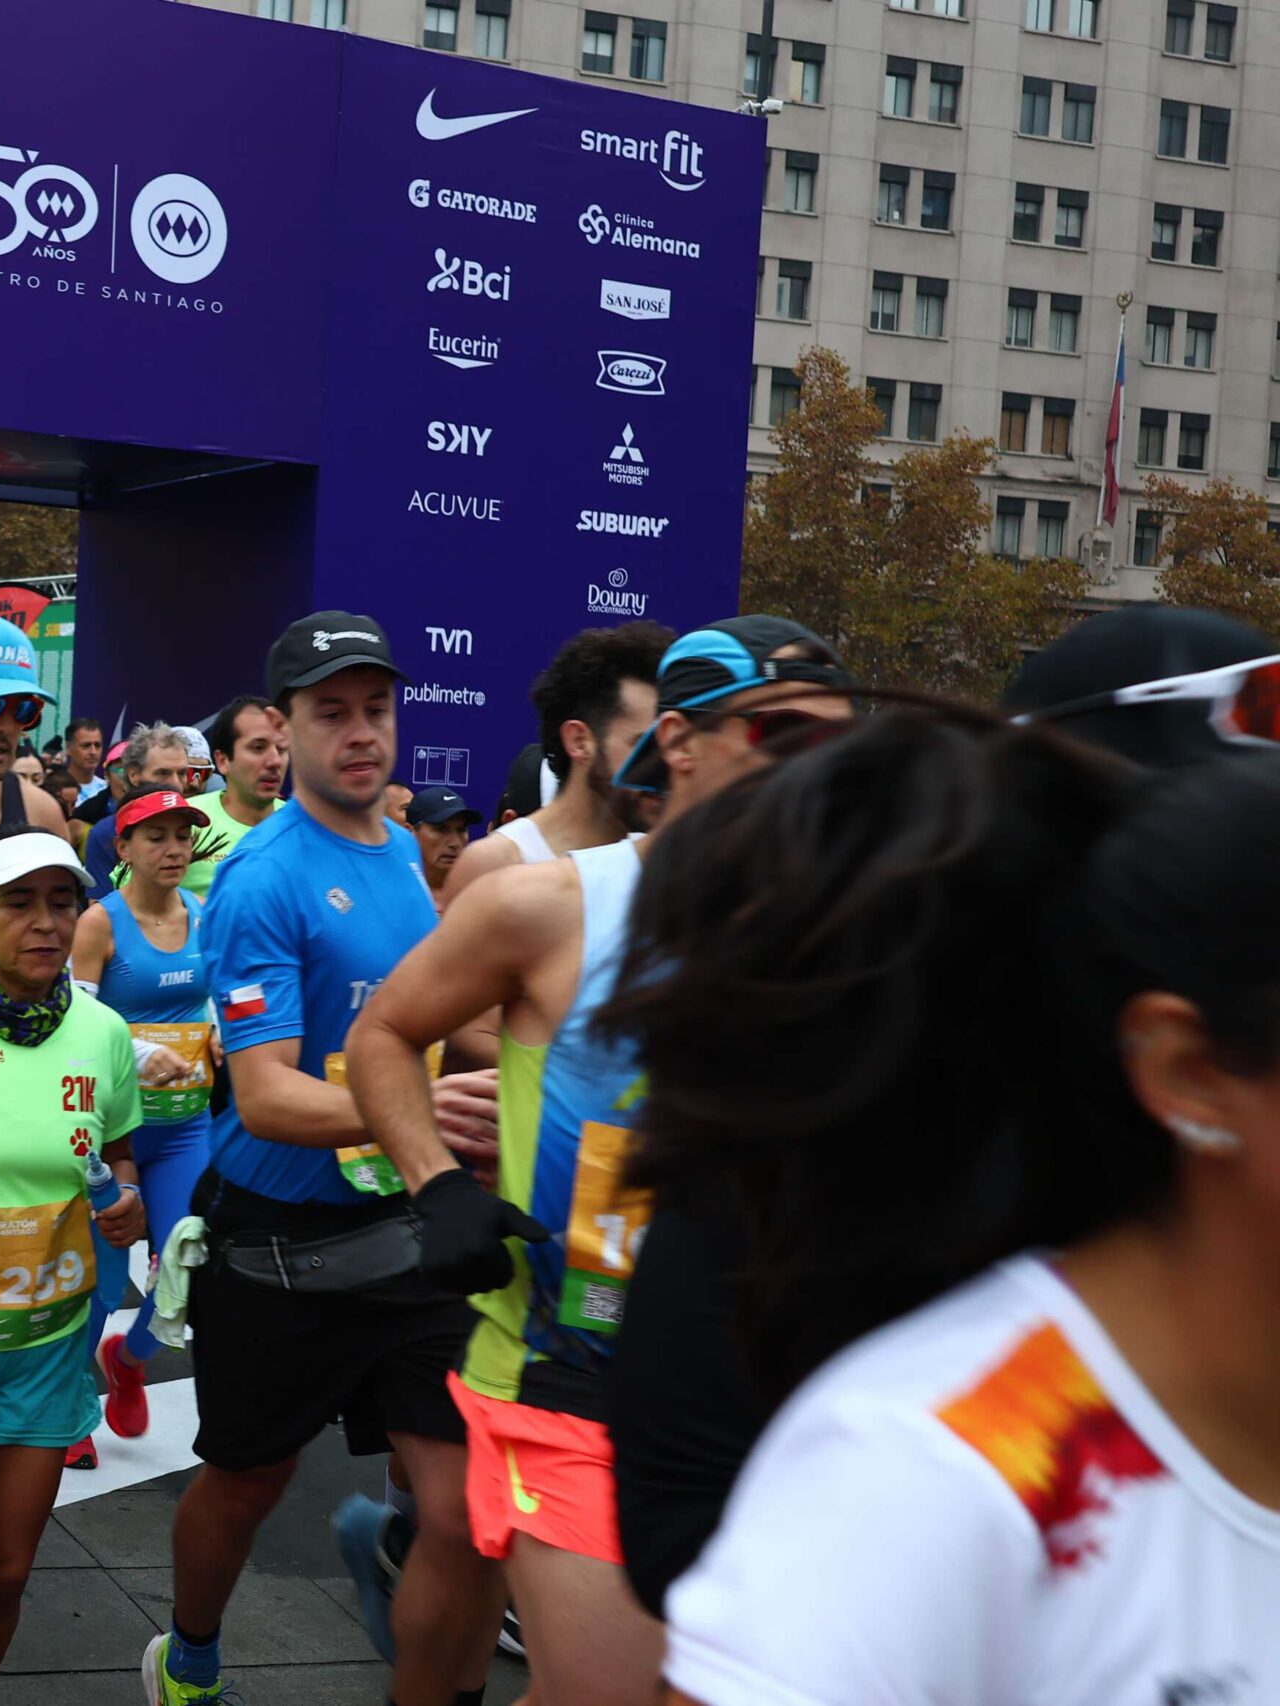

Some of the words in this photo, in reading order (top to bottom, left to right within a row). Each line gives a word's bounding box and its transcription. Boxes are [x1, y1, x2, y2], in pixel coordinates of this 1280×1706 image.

[580, 129, 659, 164] smart
[662, 130, 704, 178] fit
[437, 187, 537, 223] GATORADE
[614, 213, 655, 229] Clínica
[32, 245, 76, 262] AÑOS
[611, 227, 701, 258] Alemana
[462, 260, 512, 301] Bci
[57, 279, 86, 295] DE
[101, 285, 224, 314] SANTIAGO
[606, 293, 632, 309] SAN
[633, 298, 668, 314] JOSÉ
[428, 327, 499, 359] Eucerin
[608, 363, 652, 382] Carozzi
[426, 421, 493, 457] SKY
[602, 462, 650, 477] MITSUBISHI
[608, 473, 643, 486] MOTORS
[407, 490, 501, 521] ACUVUE
[576, 510, 670, 538] SUBWAY
[587, 584, 646, 616] Downy
[158, 969, 195, 987] XIME
[61, 1075, 97, 1112] 21K
